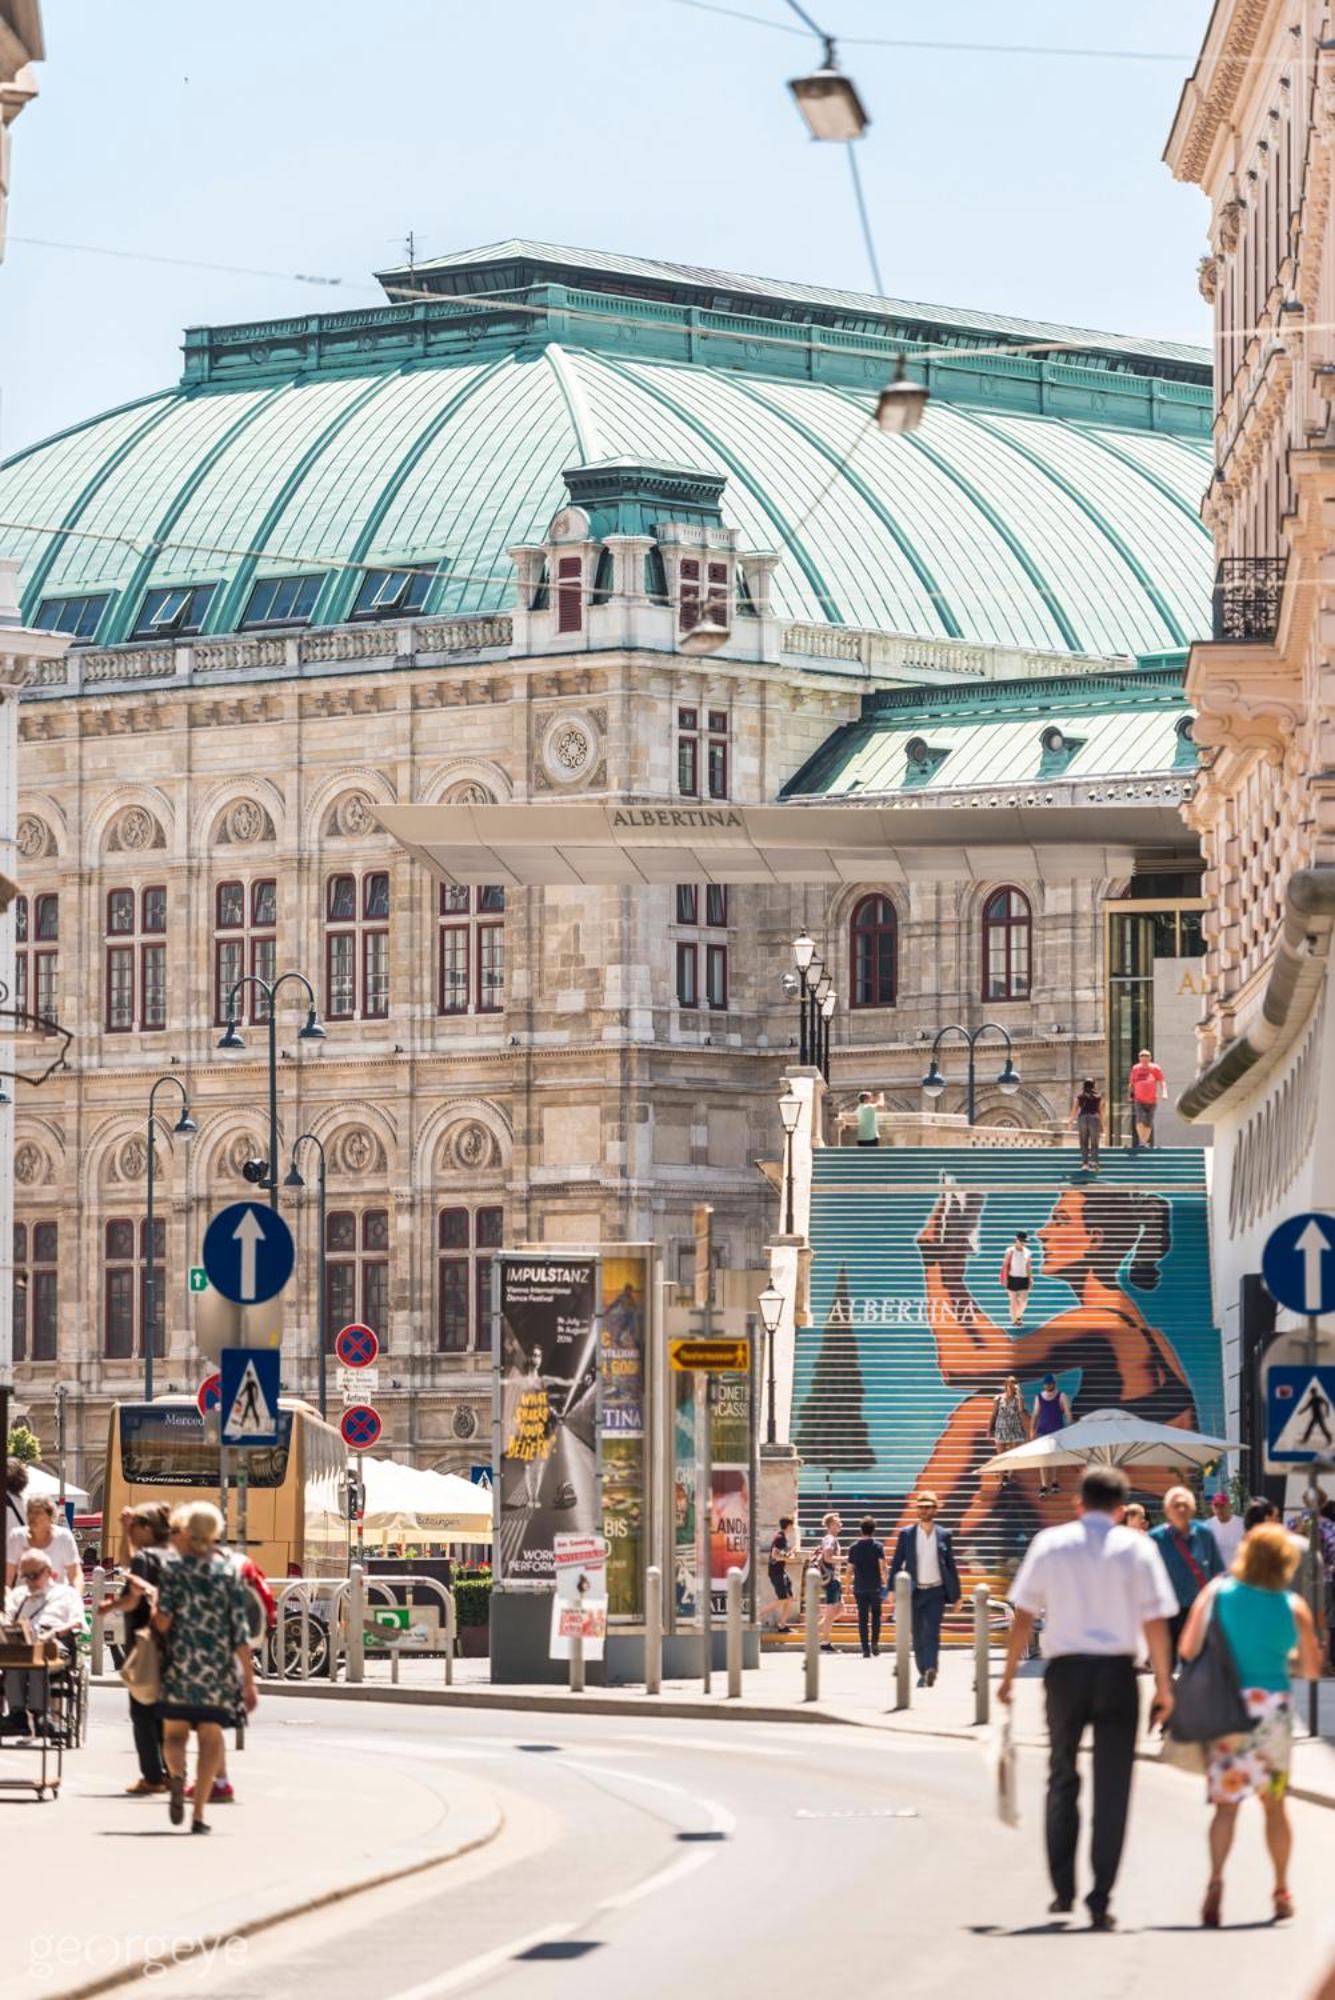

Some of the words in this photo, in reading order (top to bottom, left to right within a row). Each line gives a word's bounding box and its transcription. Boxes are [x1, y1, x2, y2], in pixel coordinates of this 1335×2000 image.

[614, 810, 741, 827] ALBERTINA
[506, 1267, 589, 1283] IMPULSTANZ
[828, 1299, 978, 1324] ALBERTINA
[346, 1393, 369, 1403] Anfang
[521, 1392, 548, 1407] WHAT
[602, 1409, 641, 1428] TINA
[136, 1476, 193, 1484] TOURISMO
[604, 1518, 628, 1537] BIS
